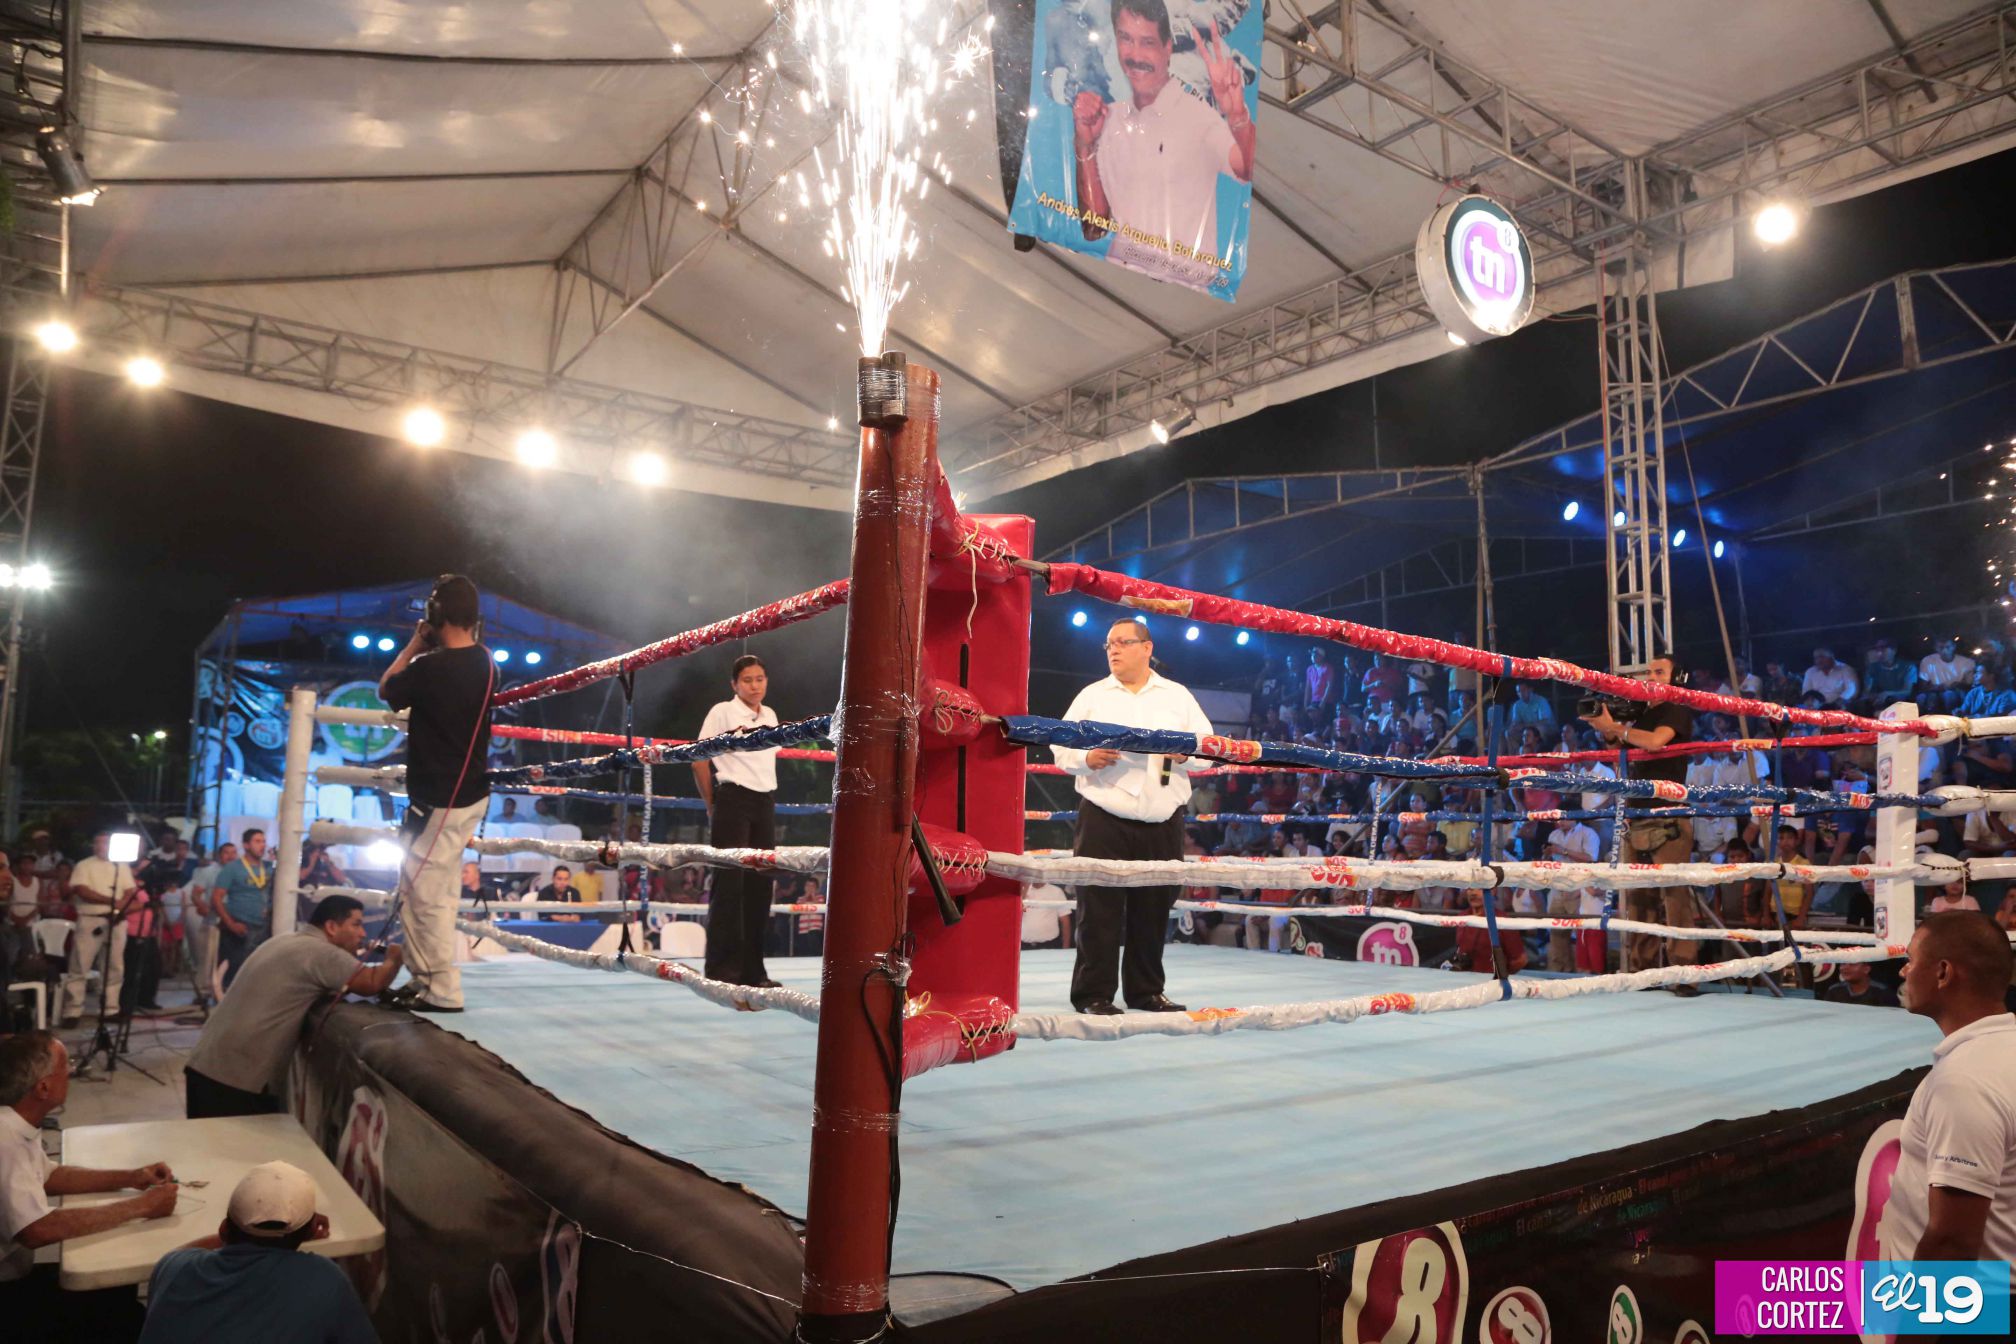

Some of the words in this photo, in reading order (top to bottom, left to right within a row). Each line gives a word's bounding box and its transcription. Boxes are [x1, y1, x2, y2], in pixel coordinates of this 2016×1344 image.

[1037, 191, 1080, 219] Andres
[1082, 209, 1119, 233] Alexis
[1121, 223, 1170, 250] Arguello
[1173, 239, 1233, 272] Bohorquez
[1470, 235, 1506, 294] tn
[1612, 829, 1621, 842] DE
[1399, 928, 1407, 940] 8
[1371, 941, 1402, 966] tn
[1950, 1155, 1978, 1168] Arbitros
[1576, 1198, 1589, 1215] de
[1590, 1185, 1634, 1211] Nicaragua
